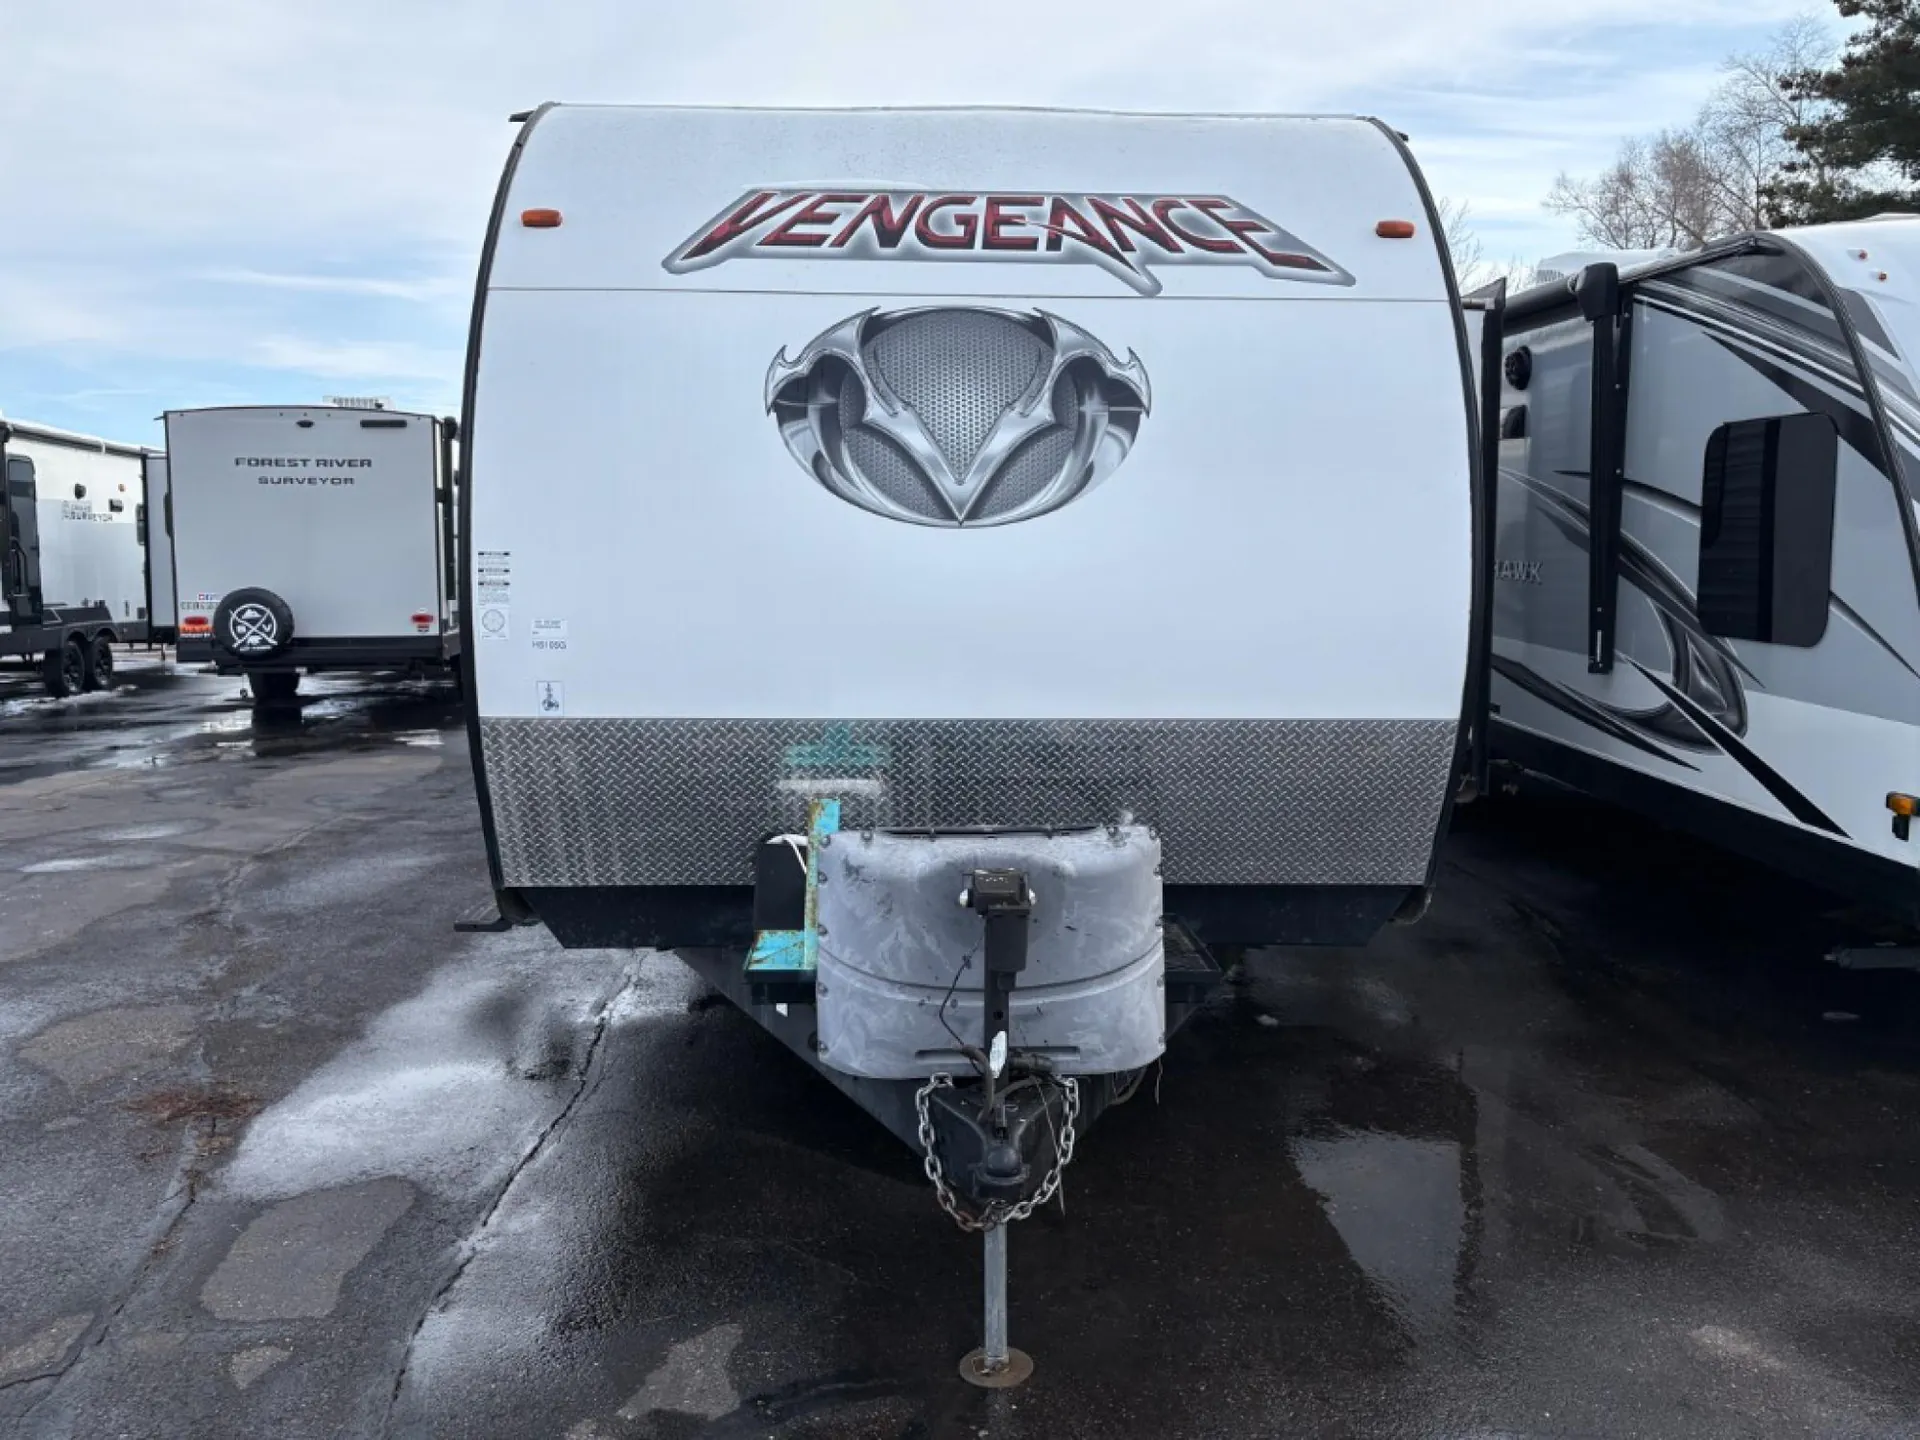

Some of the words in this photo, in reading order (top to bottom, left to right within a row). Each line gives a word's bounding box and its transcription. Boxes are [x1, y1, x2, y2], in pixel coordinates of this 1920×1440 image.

[681, 191, 1334, 275] VENGEANCE
[234, 457, 311, 468] FOREST
[315, 458, 372, 468] RIVER
[258, 475, 355, 485] SURVEYOR
